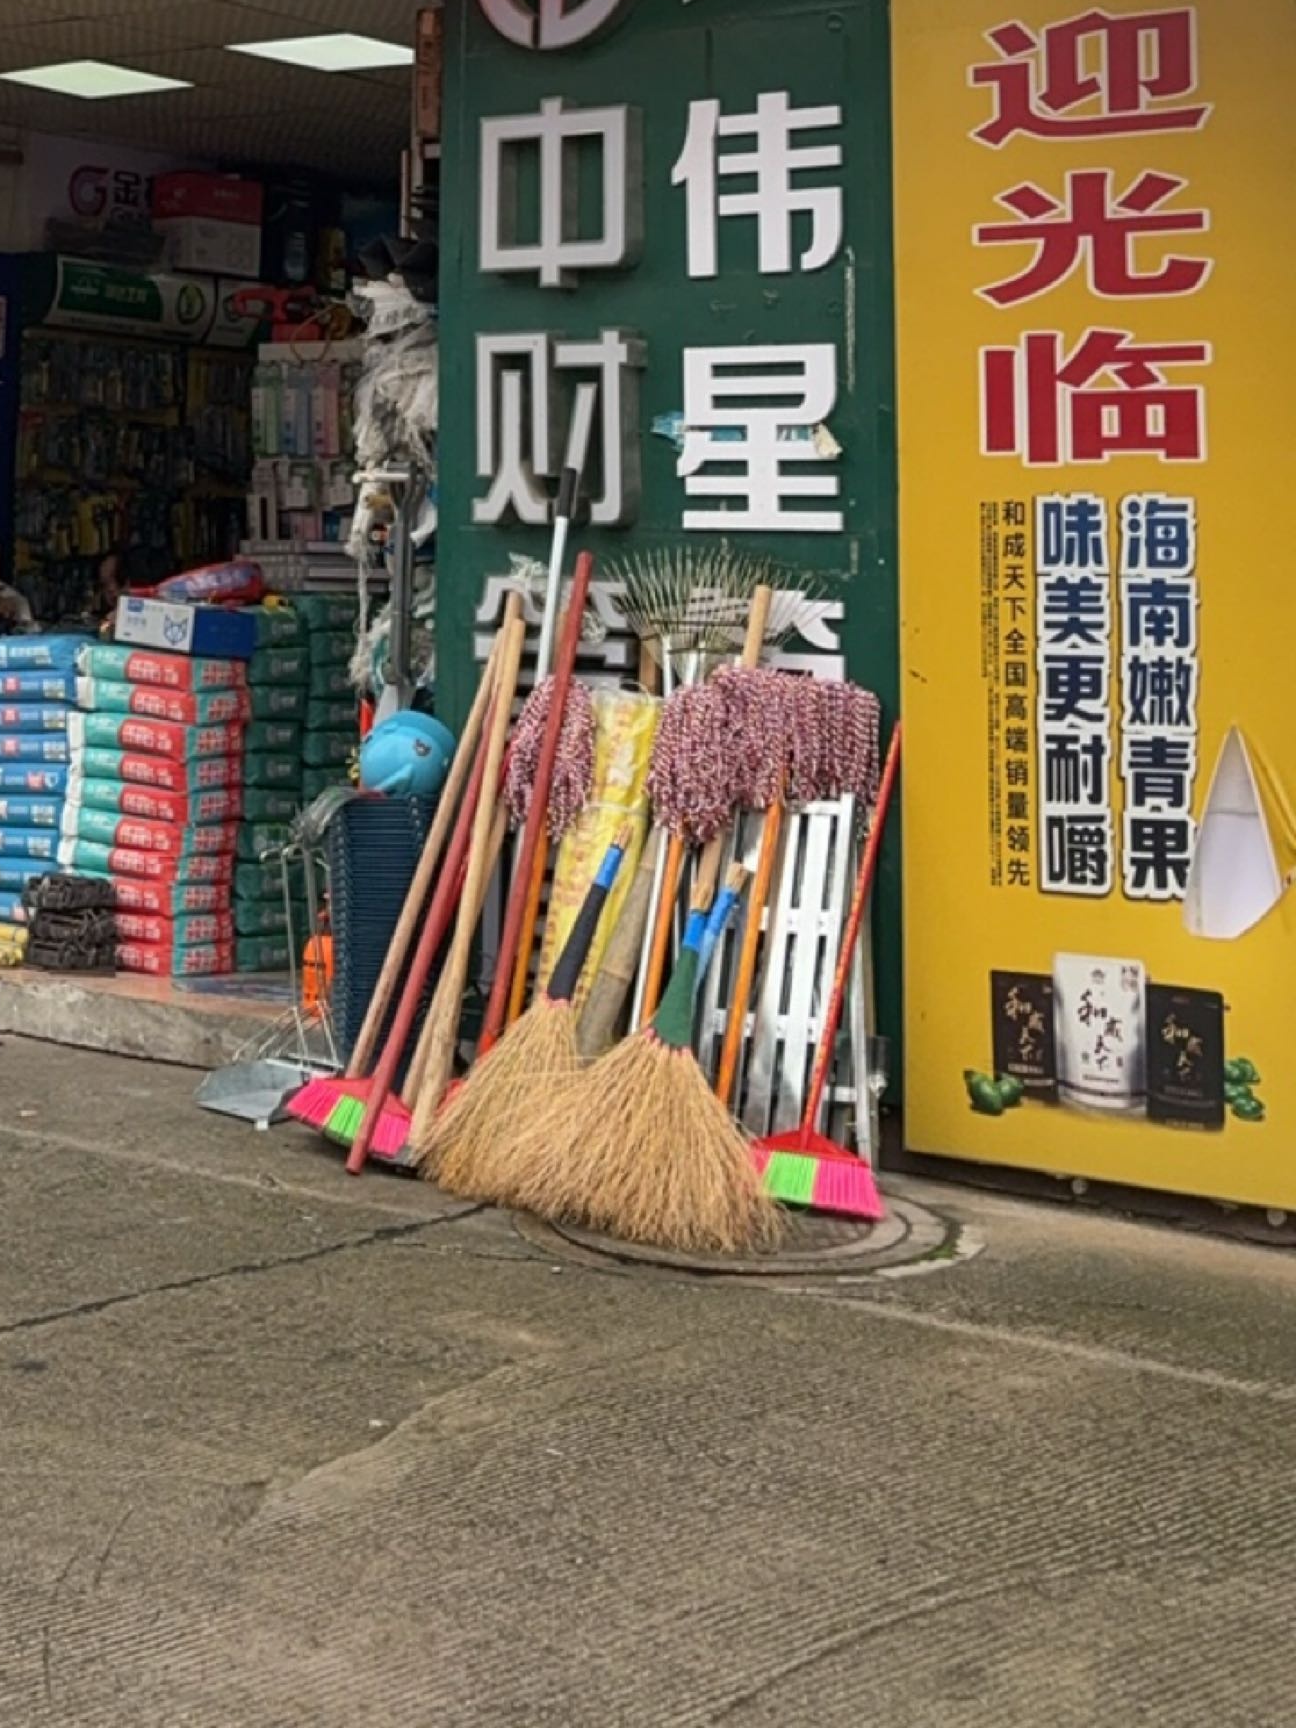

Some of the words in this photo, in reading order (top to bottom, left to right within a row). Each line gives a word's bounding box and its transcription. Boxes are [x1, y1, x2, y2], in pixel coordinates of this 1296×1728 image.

[1001, 499, 1031, 887] 和成天下全国高端销量领先
[1034, 492, 1111, 895] 味美更耐嚼
[1119, 492, 1198, 899] 海南嫩青果
